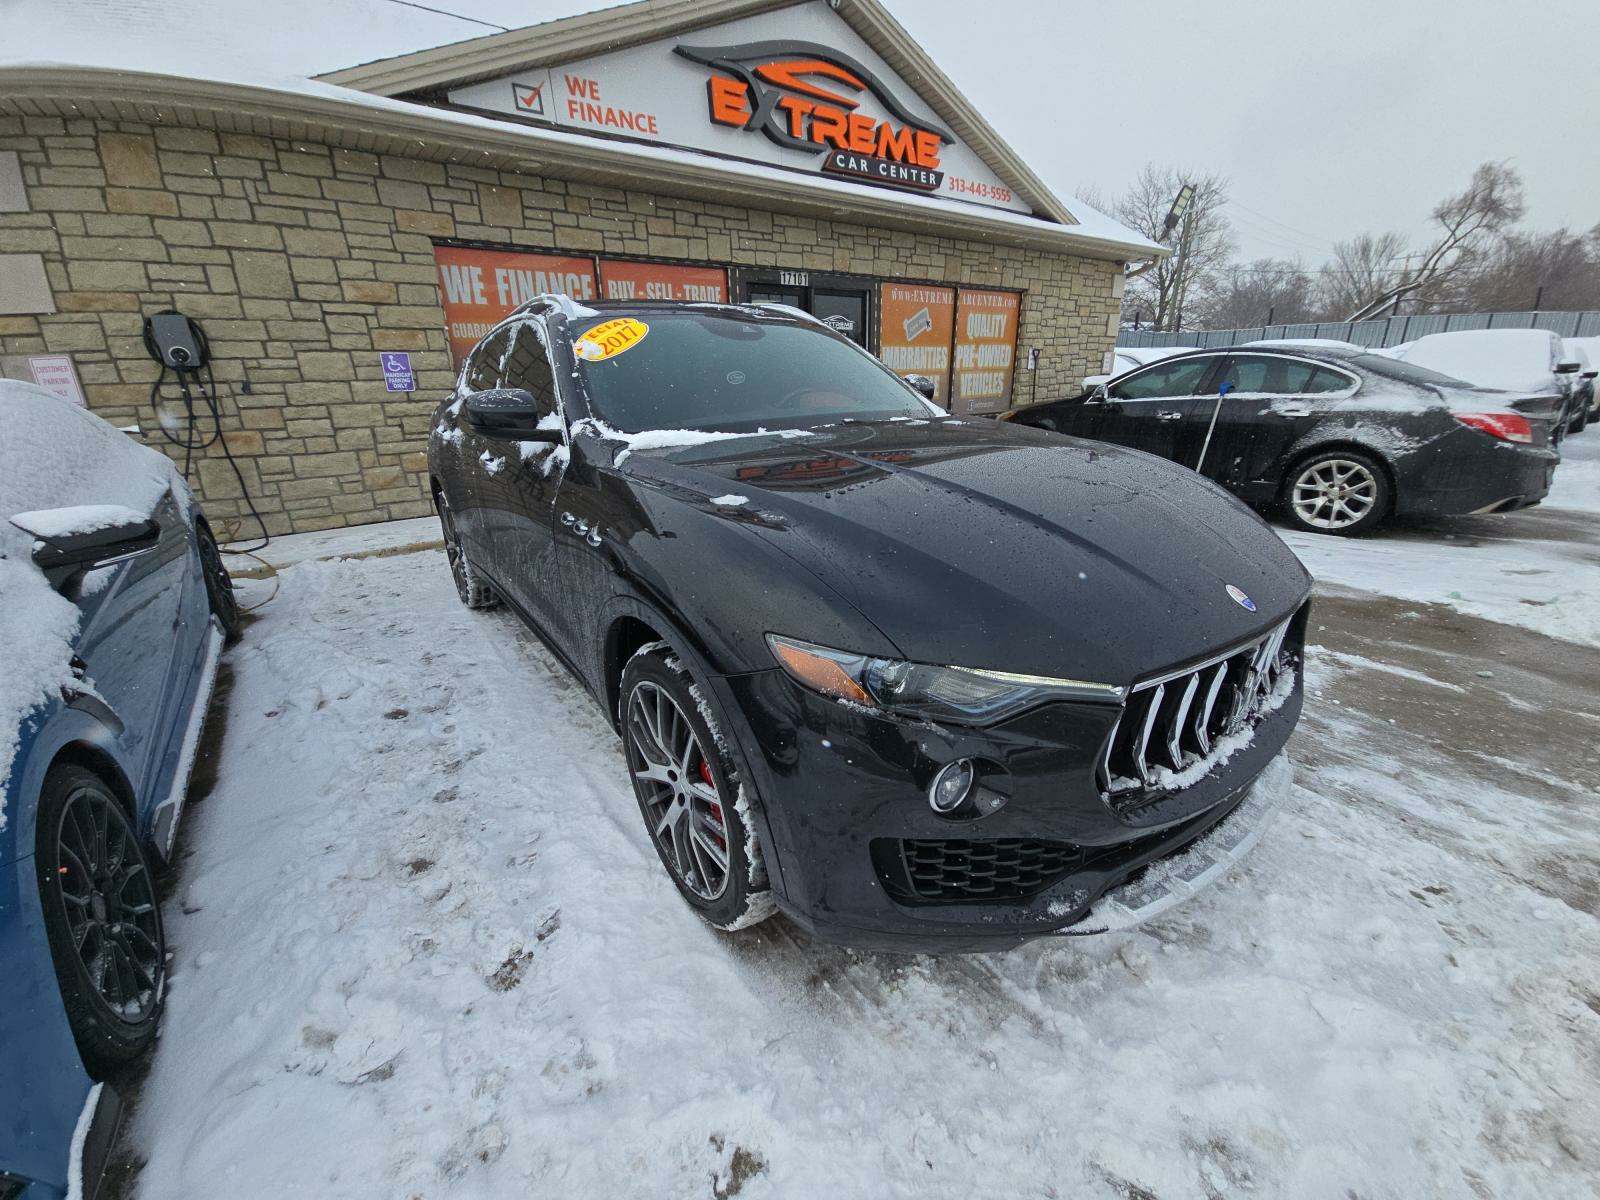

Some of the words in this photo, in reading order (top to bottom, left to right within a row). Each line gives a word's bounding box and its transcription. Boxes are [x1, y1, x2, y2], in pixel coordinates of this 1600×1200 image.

[564, 75, 601, 100] WE
[567, 99, 659, 134] FINANCE
[706, 74, 941, 170] EXTREME
[835, 154, 869, 173] CAR
[879, 163, 937, 186] CENTER
[440, 264, 488, 304] WE
[494, 267, 592, 306] FINANCE
[607, 279, 635, 300] BUY
[645, 281, 673, 301] SELL
[682, 283, 721, 303] TRADE
[967, 313, 1007, 339] QUALITY
[598, 325, 638, 355] 2017
[881, 346, 948, 369] WARRANTIES
[955, 344, 1012, 368] PRE-OWNED
[961, 372, 1004, 396] VEHICLES
